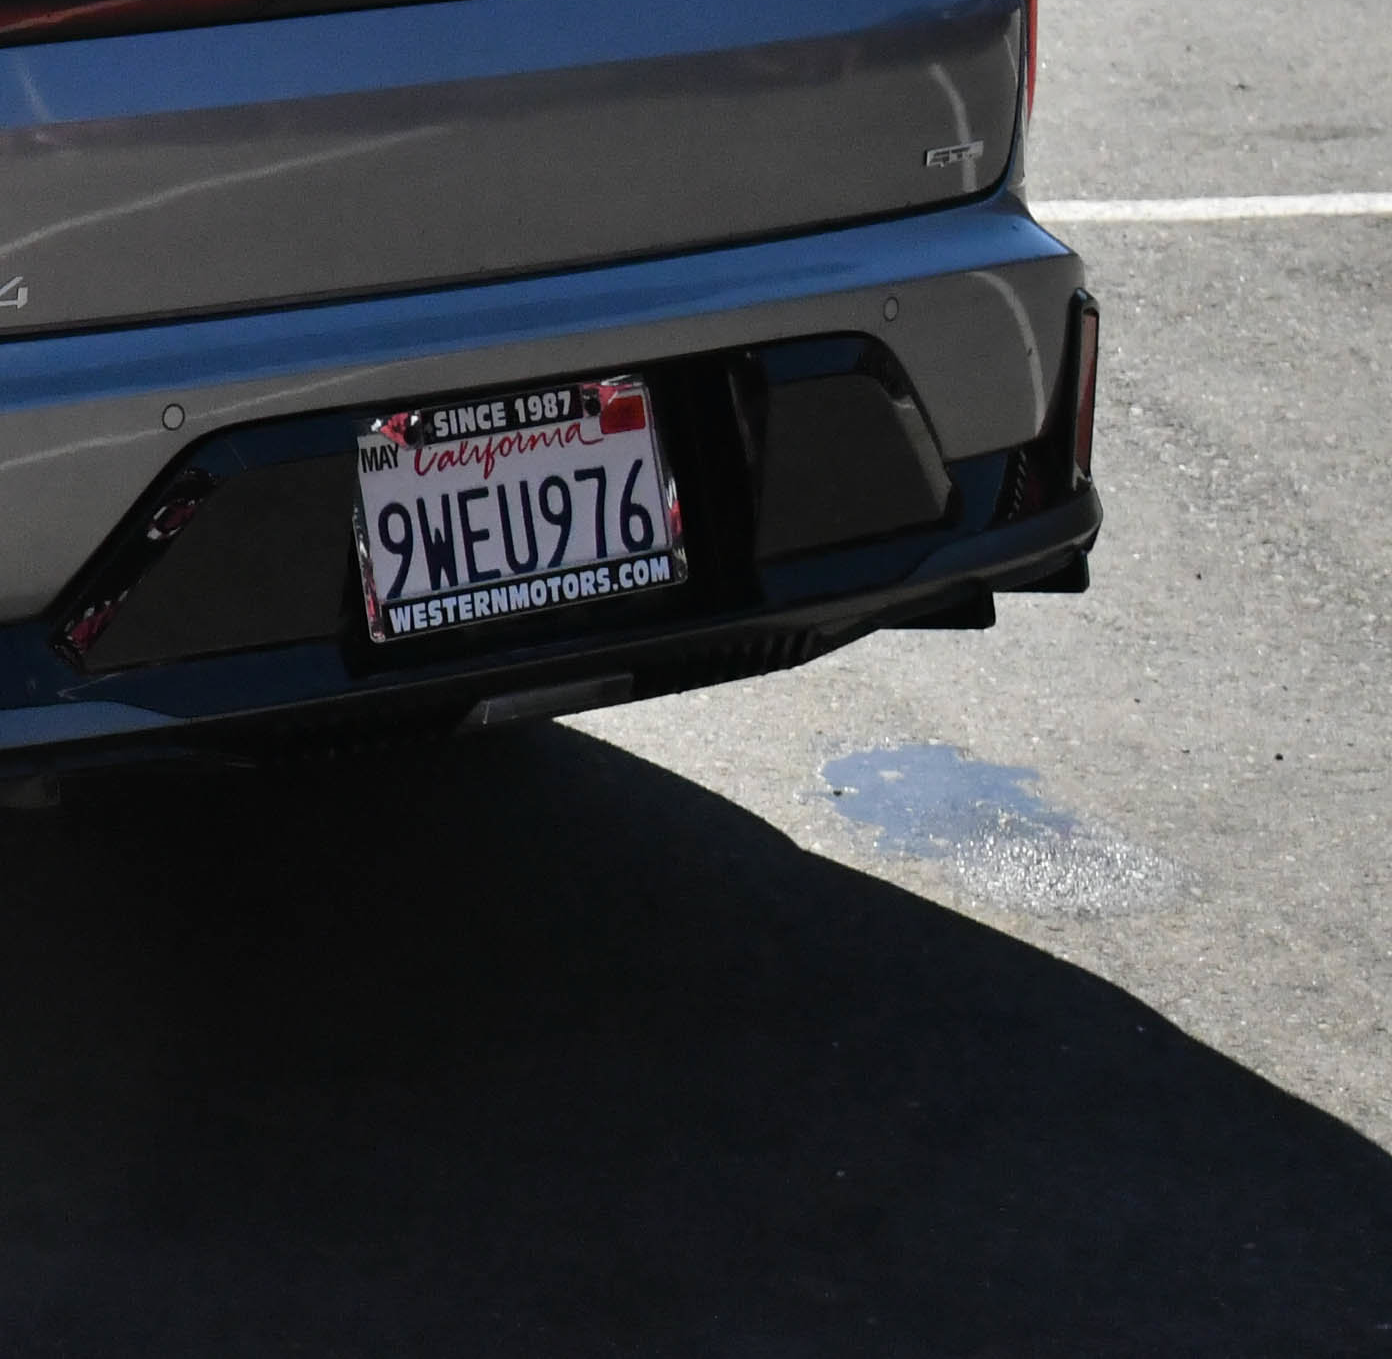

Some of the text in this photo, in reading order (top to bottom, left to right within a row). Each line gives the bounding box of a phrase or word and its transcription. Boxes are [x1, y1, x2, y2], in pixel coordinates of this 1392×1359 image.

[433, 390, 571, 438] SINCE 1987
[361, 444, 400, 473] MAY
[414, 422, 604, 479] California
[378, 459, 655, 601] 9WEU976
[389, 556, 671, 633] WESTERNMOTORS.COM
